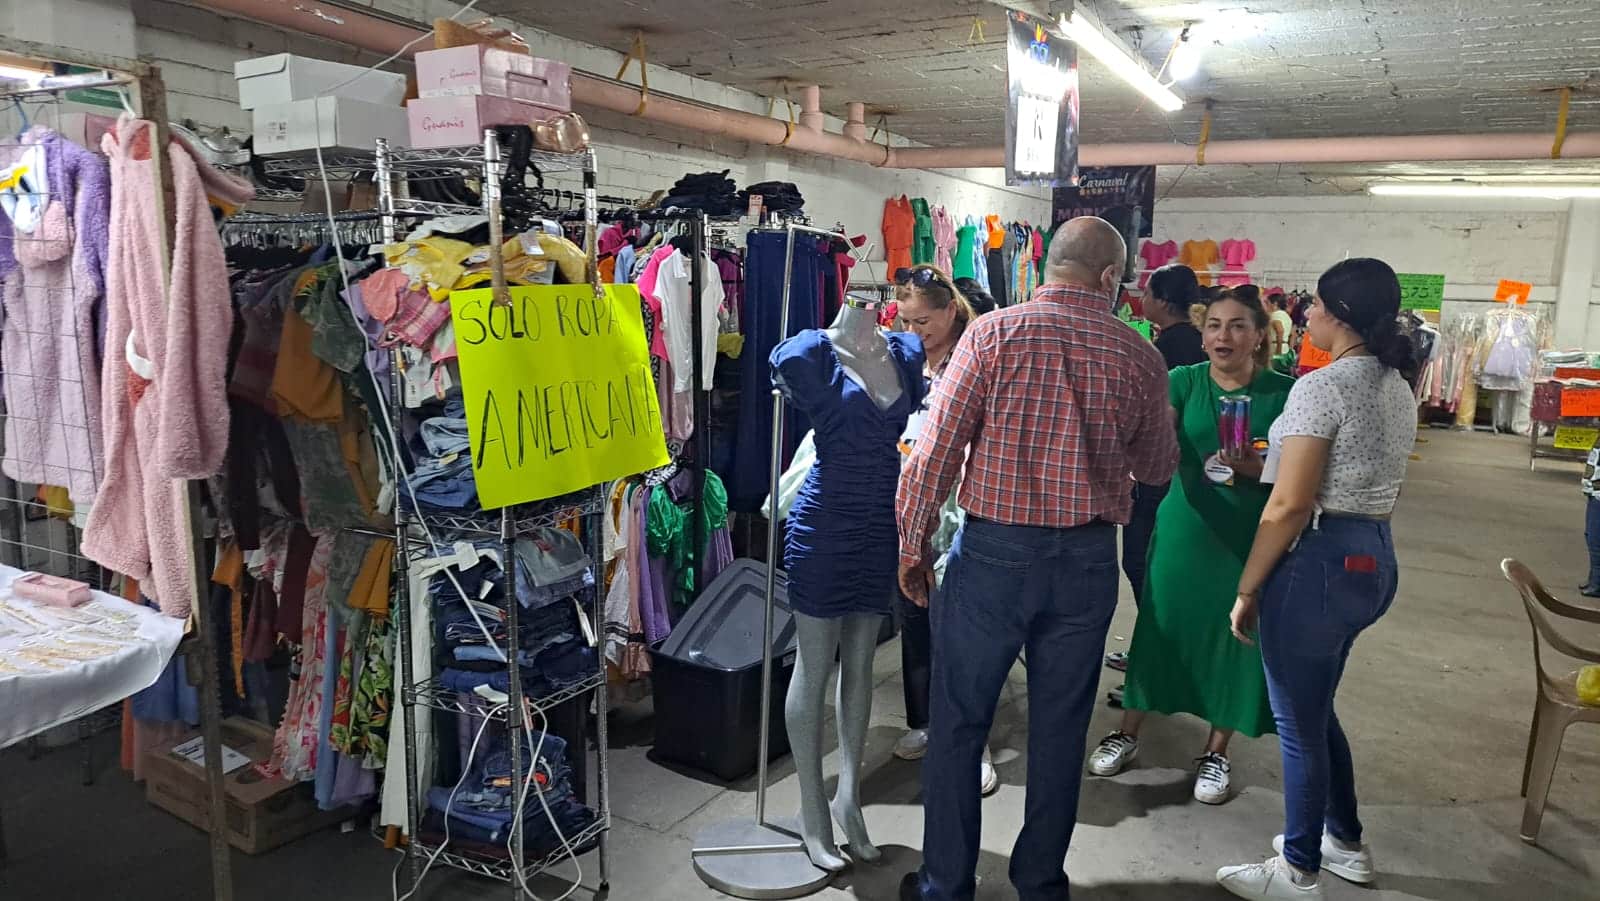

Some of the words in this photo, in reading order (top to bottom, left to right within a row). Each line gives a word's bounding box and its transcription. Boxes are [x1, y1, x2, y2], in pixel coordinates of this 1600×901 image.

[1079, 172, 1128, 188] Carnaval
[459, 295, 542, 345] SOLO
[556, 295, 624, 337] ROPA
[476, 366, 664, 470] AMERICANA
